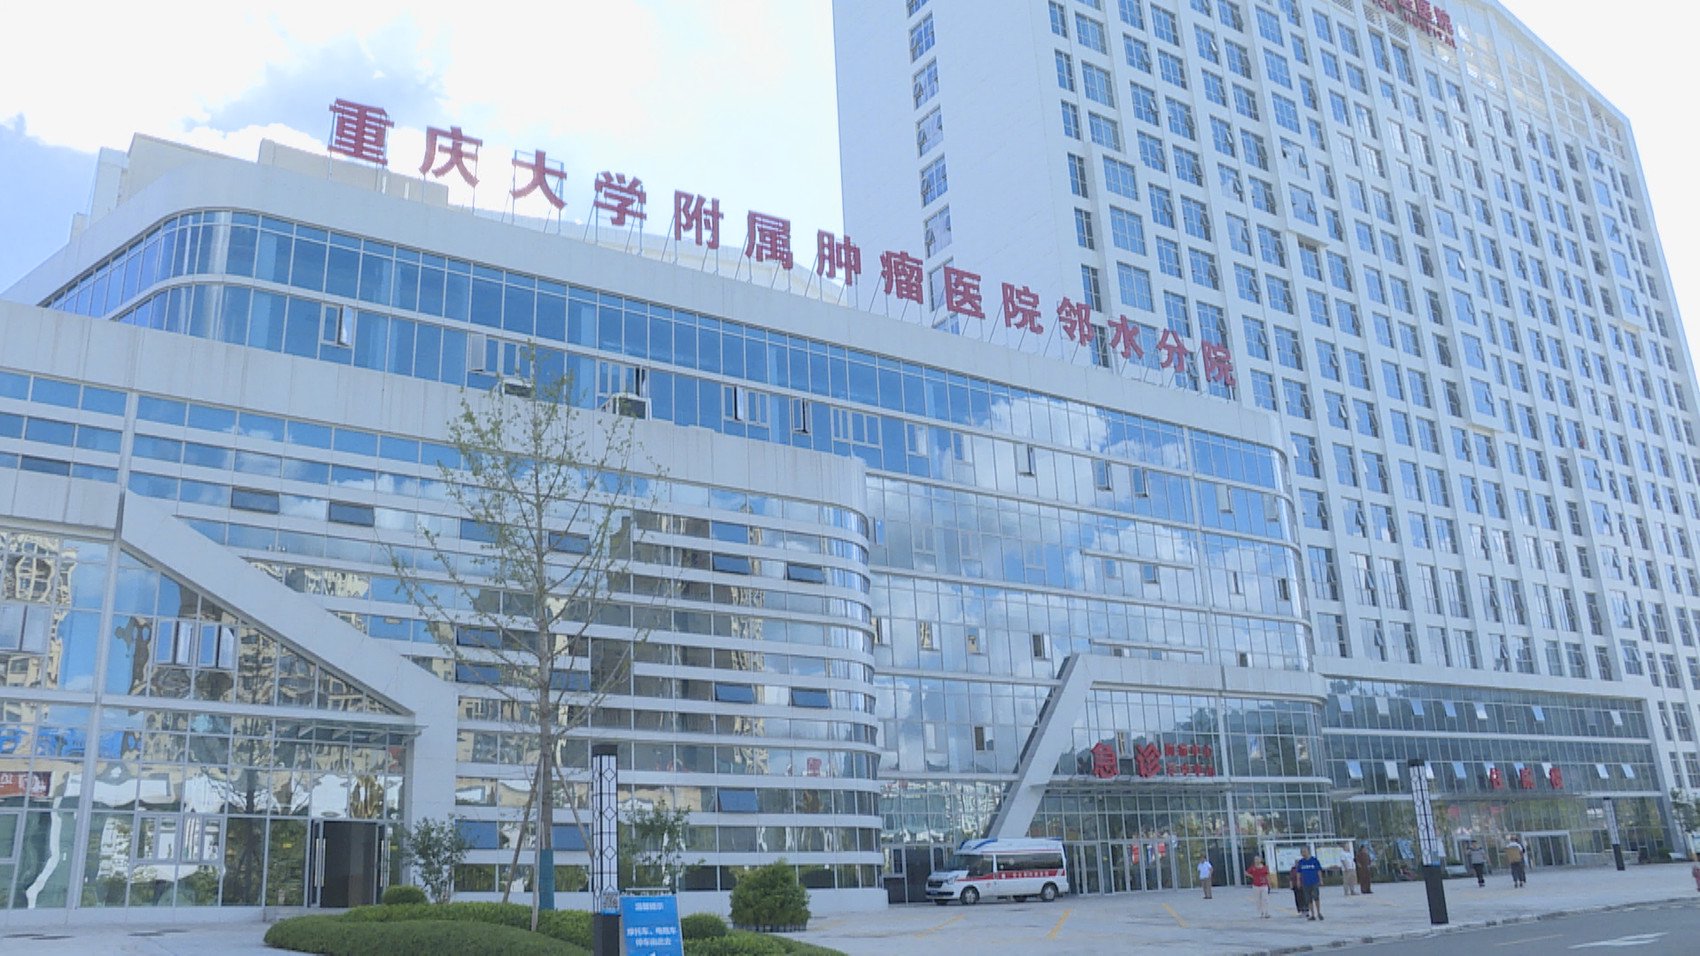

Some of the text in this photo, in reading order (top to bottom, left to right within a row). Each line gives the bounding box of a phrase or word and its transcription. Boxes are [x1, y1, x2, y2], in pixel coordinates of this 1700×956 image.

[327, 97, 1236, 387] 重庆大学附属肿瘤医院邻水分院
[1091, 742, 1162, 778] 急诊
